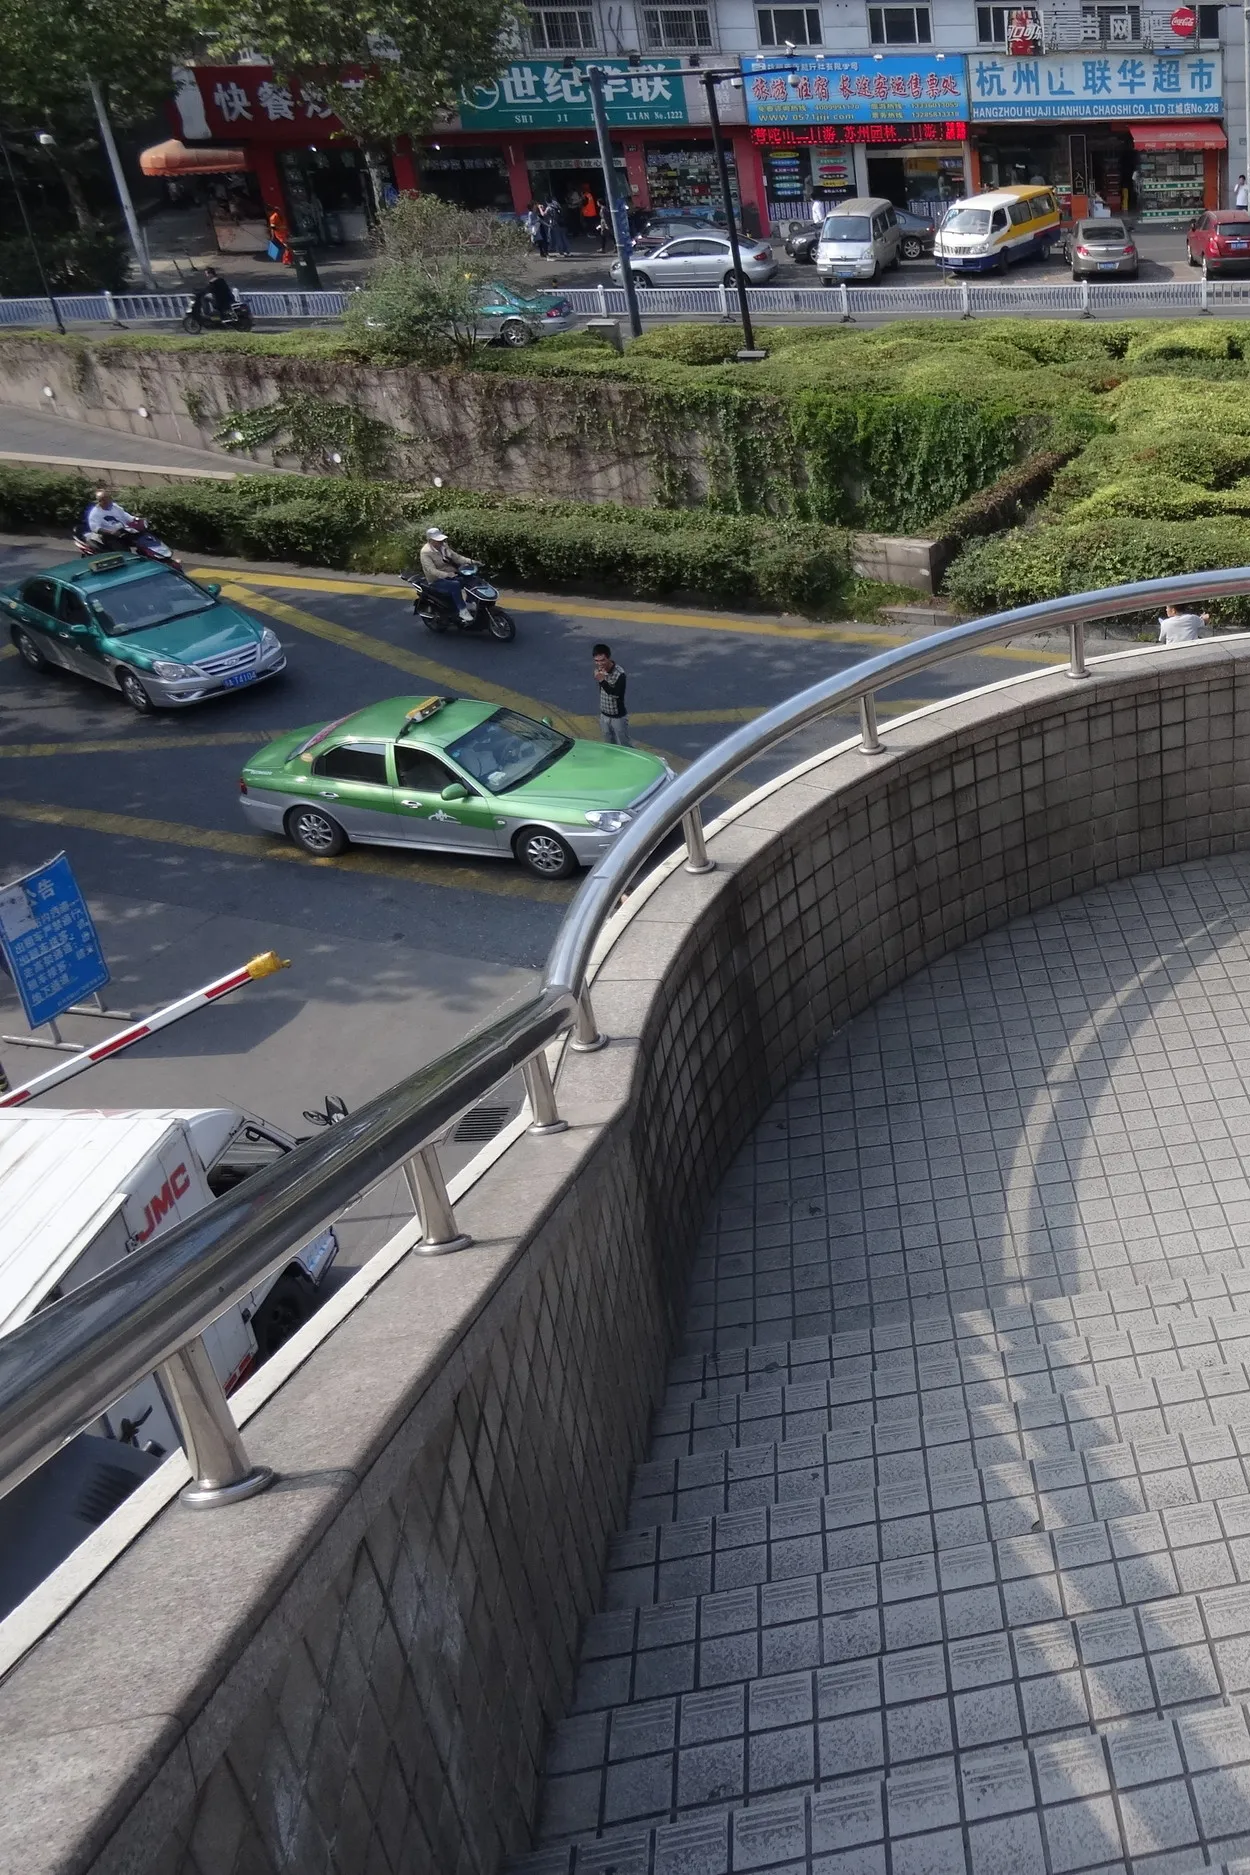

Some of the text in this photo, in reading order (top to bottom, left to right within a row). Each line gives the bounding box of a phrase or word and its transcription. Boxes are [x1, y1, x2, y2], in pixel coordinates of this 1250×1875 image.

[1171, 16, 1194, 27] Coca-Cola
[499, 63, 672, 104] 世纪华联
[752, 76, 788, 101] 旅游
[838, 71, 961, 101] 长途客运售票处
[214, 80, 364, 122] 快餐炒
[972, 106, 1023, 118] HANGZHOU
[1024, 105, 1051, 117] HUAJI
[1053, 104, 1091, 117] LIANHUA
[1092, 104, 1131, 116] CHAOSHI
[514, 113, 534, 124] SHI
[557, 113, 569, 123] JI
[626, 111, 650, 121] LIAN
[843, 124, 897, 140] 苏州园林
[136, 1162, 191, 1243] JMC
